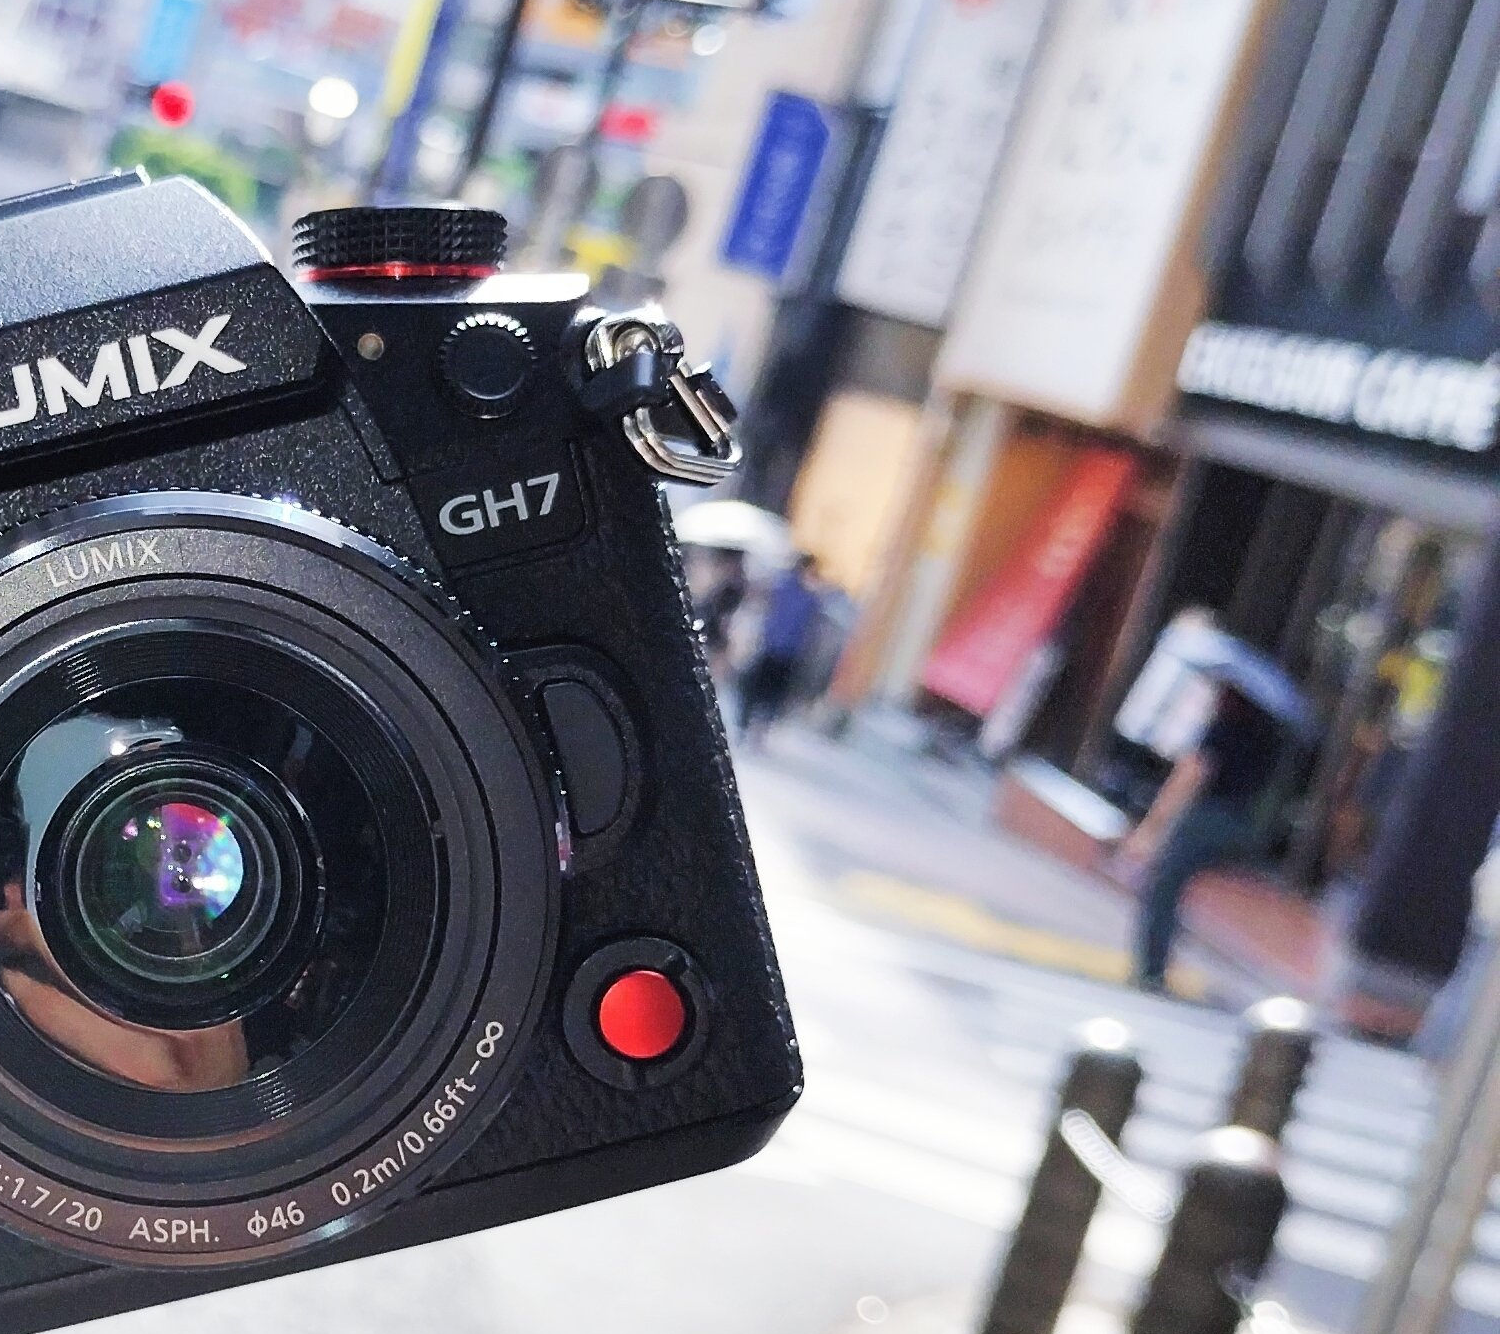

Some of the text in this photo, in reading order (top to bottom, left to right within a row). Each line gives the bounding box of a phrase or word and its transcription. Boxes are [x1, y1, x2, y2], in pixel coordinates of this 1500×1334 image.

[438, 471, 560, 536] GH7
[44, 535, 163, 588] LUMIX
[128, 1216, 221, 1244] ASPH.
